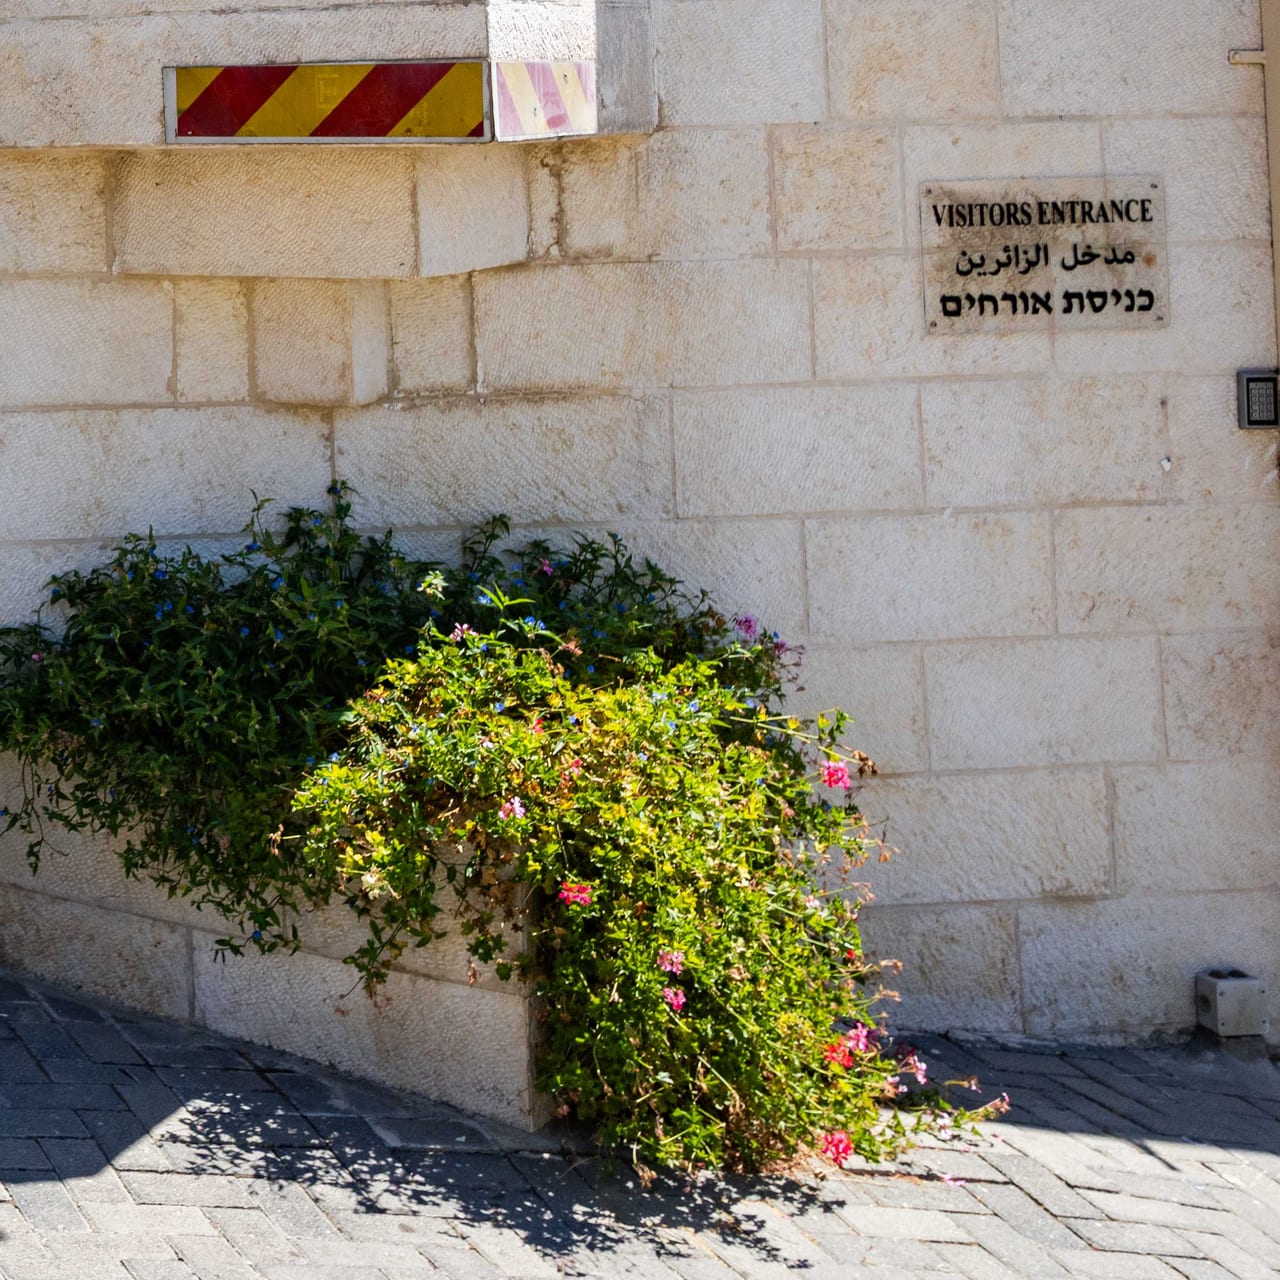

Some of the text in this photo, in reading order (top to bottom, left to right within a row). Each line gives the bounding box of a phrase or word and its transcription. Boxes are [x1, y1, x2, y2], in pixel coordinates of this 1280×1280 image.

[932, 198, 1154, 228] VISITORS ENTRANCE
[955, 243, 1137, 276] مدخل الزائرين
[940, 288, 1156, 317] כניסת אורחים
